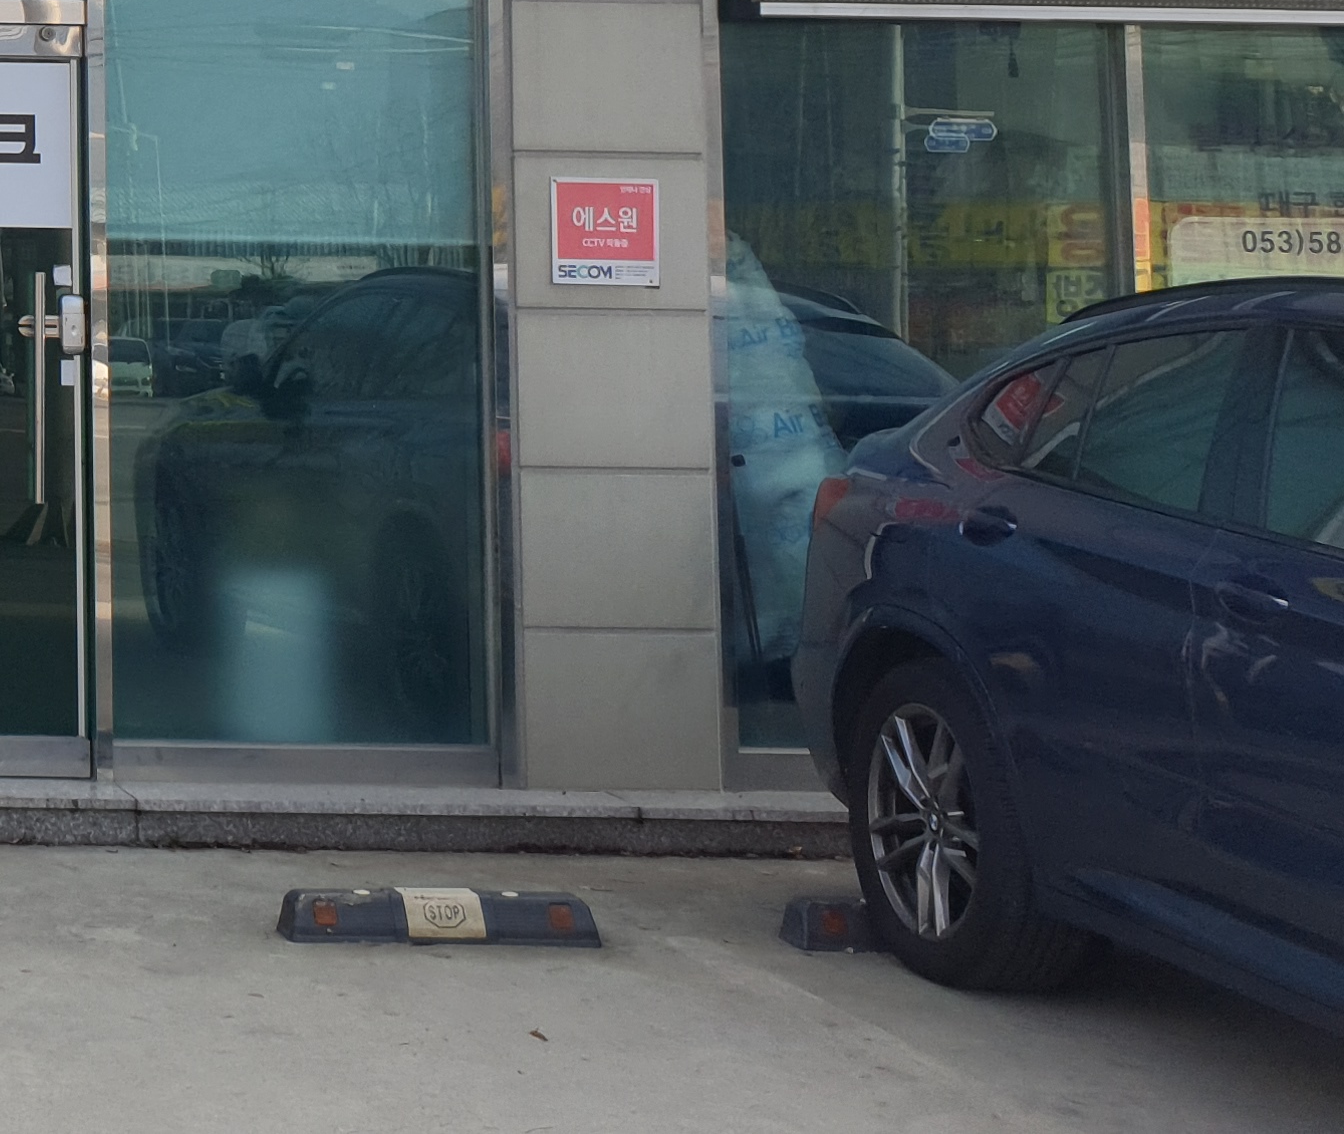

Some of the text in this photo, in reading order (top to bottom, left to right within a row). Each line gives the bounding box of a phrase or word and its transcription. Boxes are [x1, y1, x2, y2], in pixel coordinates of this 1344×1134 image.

[572, 206, 637, 232] 에스원
[558, 265, 612, 279] SECOM
[429, 905, 460, 921] STOP
